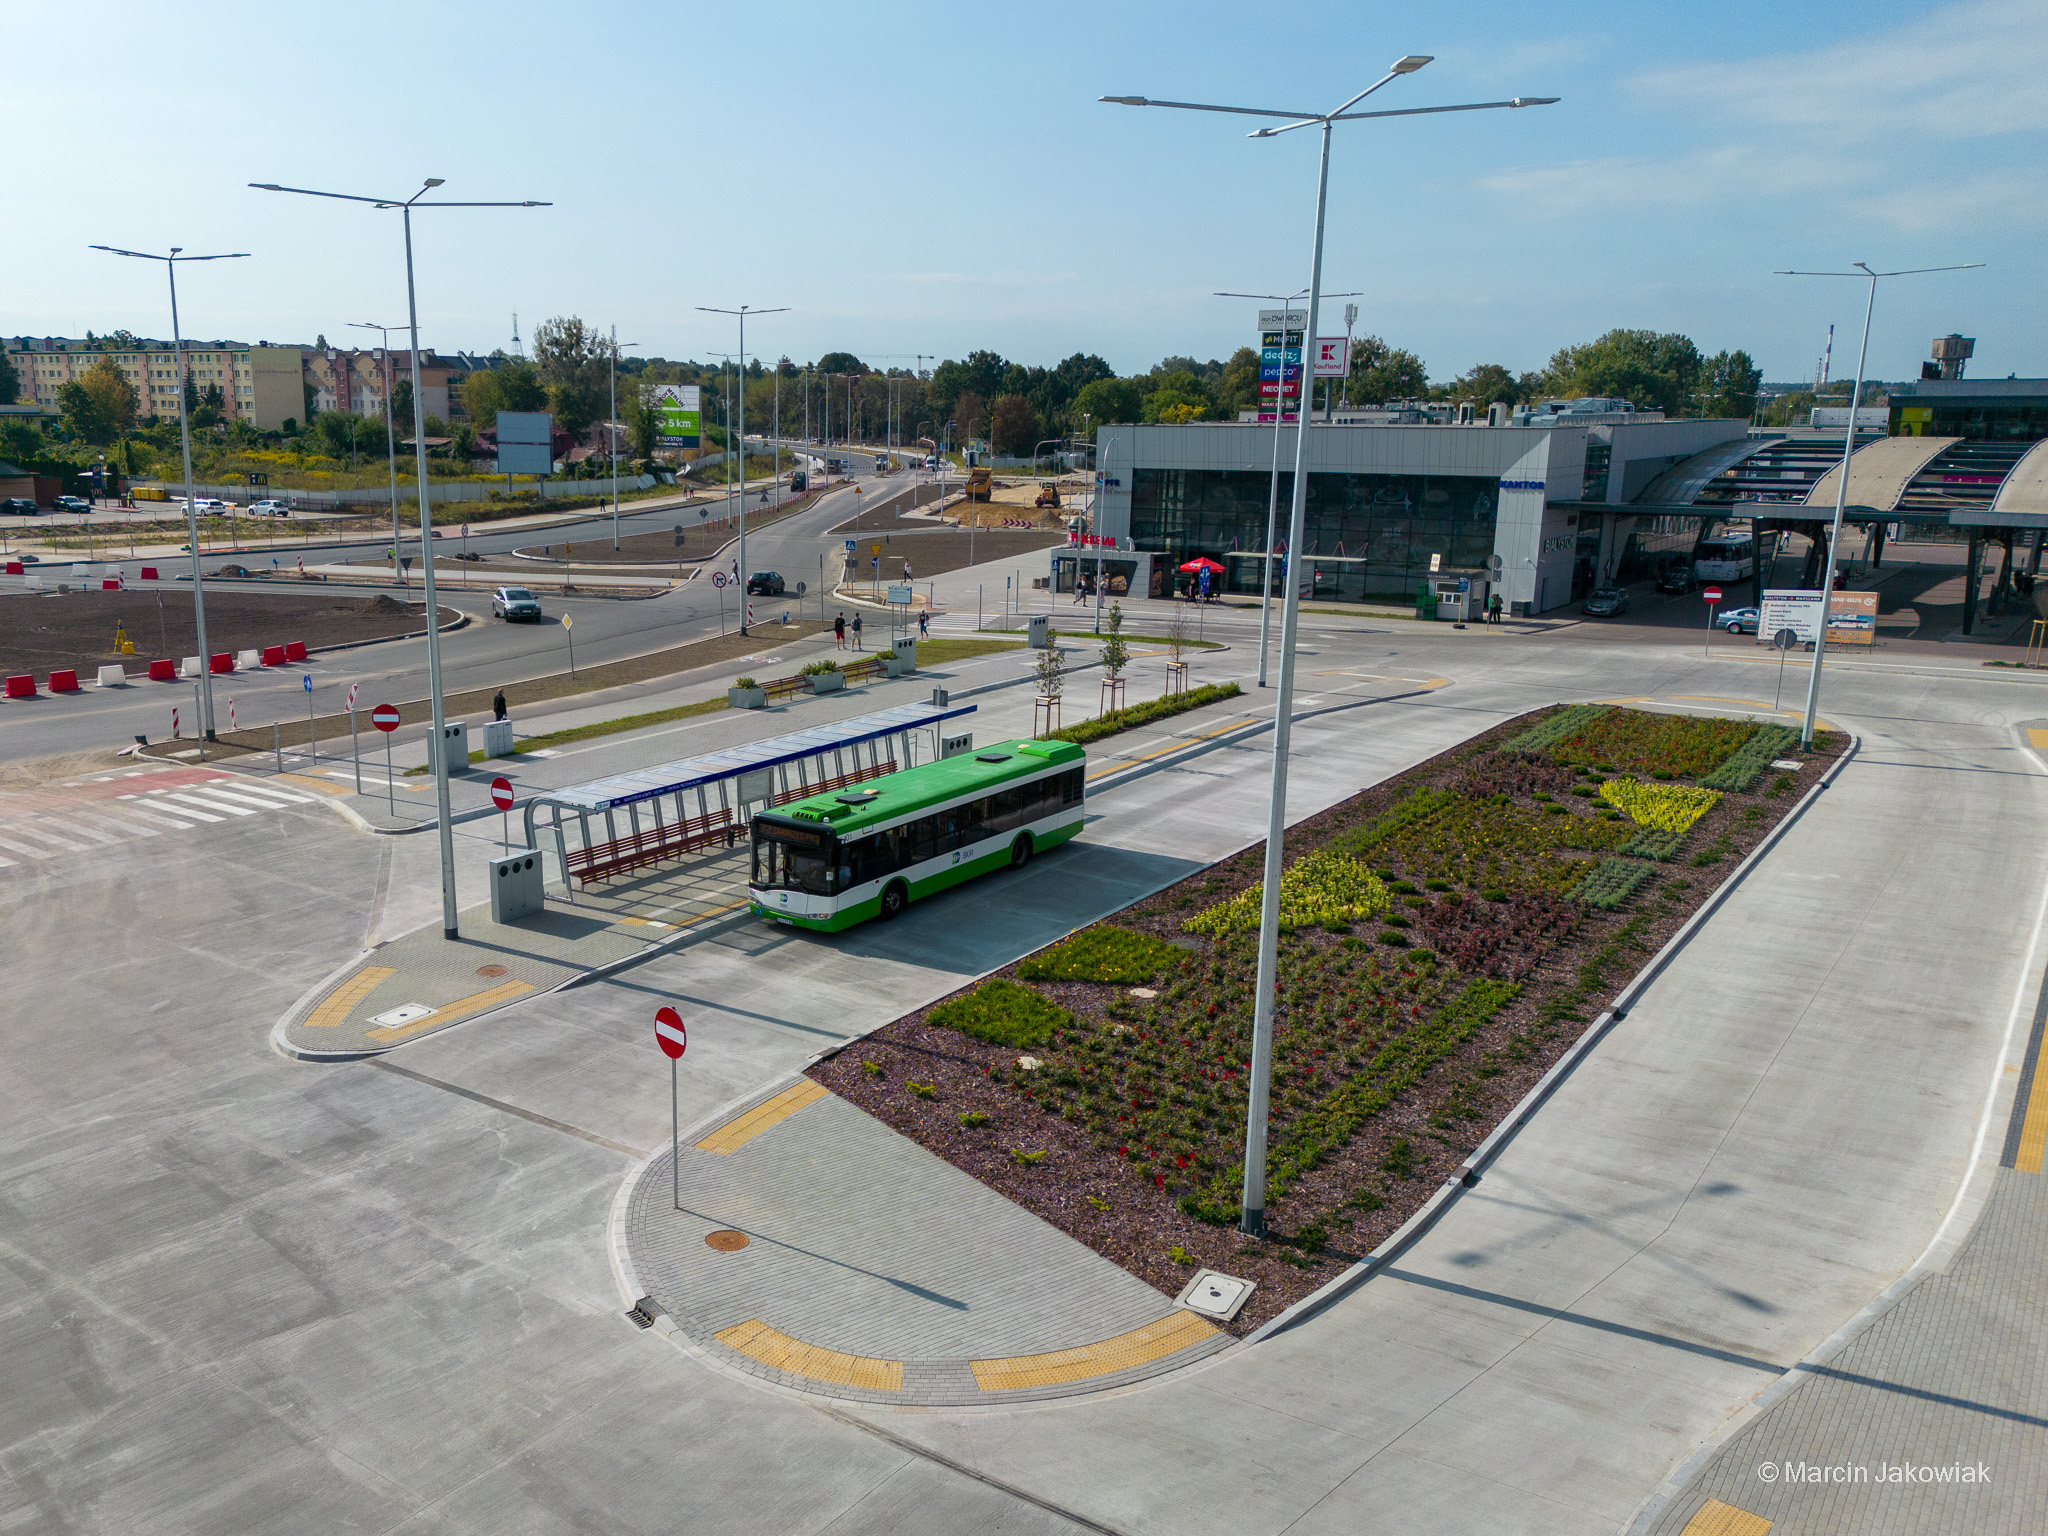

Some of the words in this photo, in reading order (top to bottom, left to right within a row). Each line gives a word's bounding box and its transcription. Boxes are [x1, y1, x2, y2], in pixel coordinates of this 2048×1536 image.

[1271, 314, 1302, 322] DWRCU
[668, 419, 675, 428] 5
[676, 418, 691, 428] km
[1105, 478, 1120, 487] PFR
[1499, 480, 1545, 490] KANTOR
